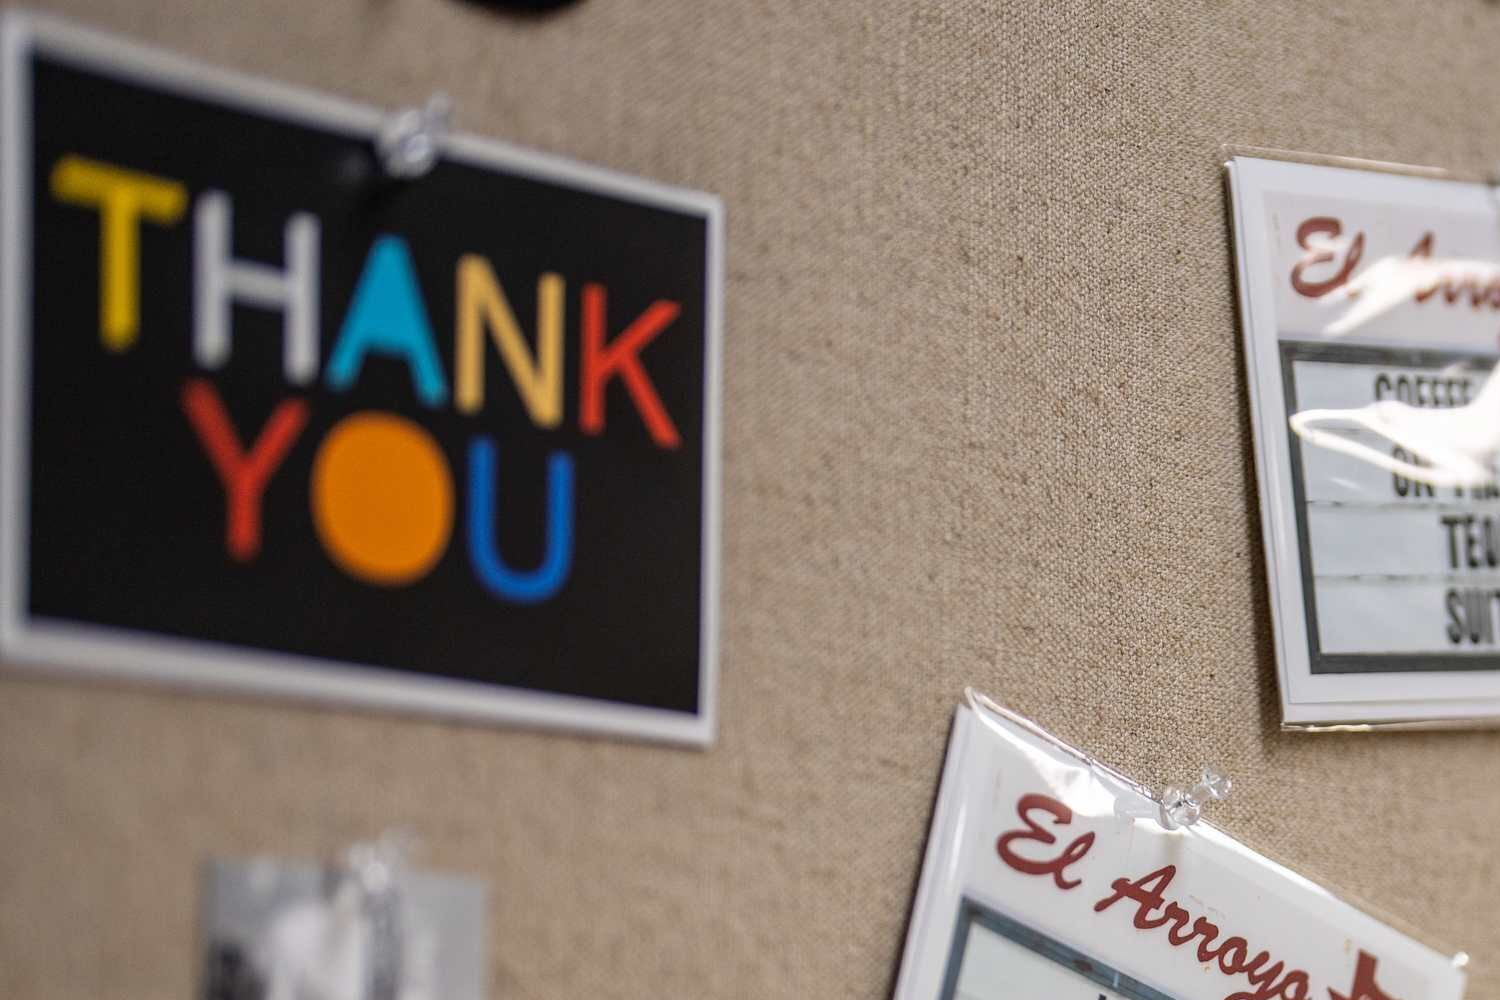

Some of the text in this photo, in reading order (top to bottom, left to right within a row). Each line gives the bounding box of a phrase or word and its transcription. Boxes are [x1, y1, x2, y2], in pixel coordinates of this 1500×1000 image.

[50, 155, 680, 448] THANK
[1291, 216, 1364, 298] El
[183, 379, 573, 602] YOU
[997, 793, 1095, 890] El
